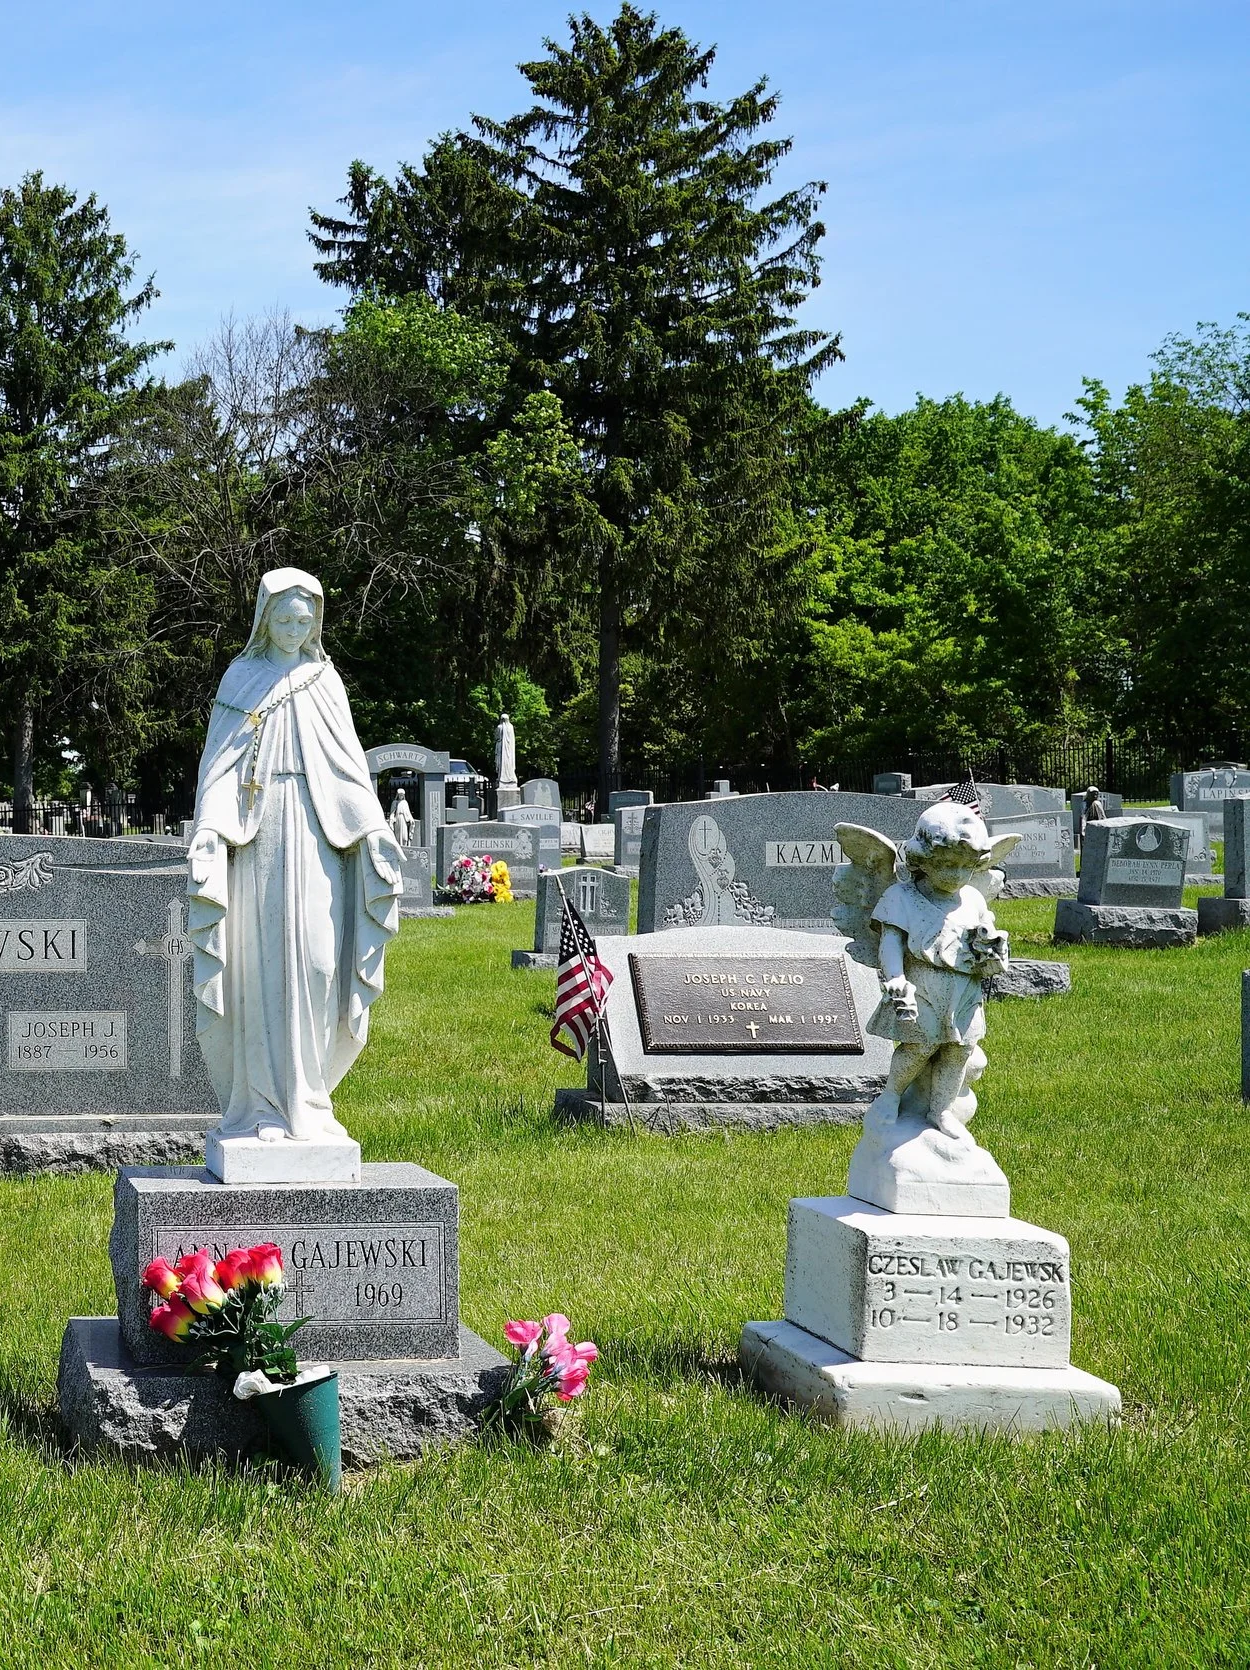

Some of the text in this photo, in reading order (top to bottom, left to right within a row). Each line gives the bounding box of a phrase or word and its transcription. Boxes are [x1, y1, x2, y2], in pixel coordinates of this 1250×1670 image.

[377, 752, 425, 763] SCHWARTZ
[472, 840, 513, 849] ZIELINSKI
[684, 974, 804, 985] JOSEPH C FAZIO
[720, 988, 771, 998] US NAVY
[730, 1002, 768, 1011] KOREA
[663, 1015, 689, 1024] NOV
[708, 1015, 735, 1024] 1933
[768, 1014, 793, 1024] MAR
[812, 1014, 838, 1024] 1997
[21, 1021, 95, 1039] JOSEPH
[17, 1045, 119, 1059] 1887 1956
[291, 1238, 427, 1270] GAJEWSKI
[355, 1282, 403, 1308] 1969
[883, 1281, 1056, 1309] 3 14 1926
[871, 1307, 1055, 1336] 10 18 1932
